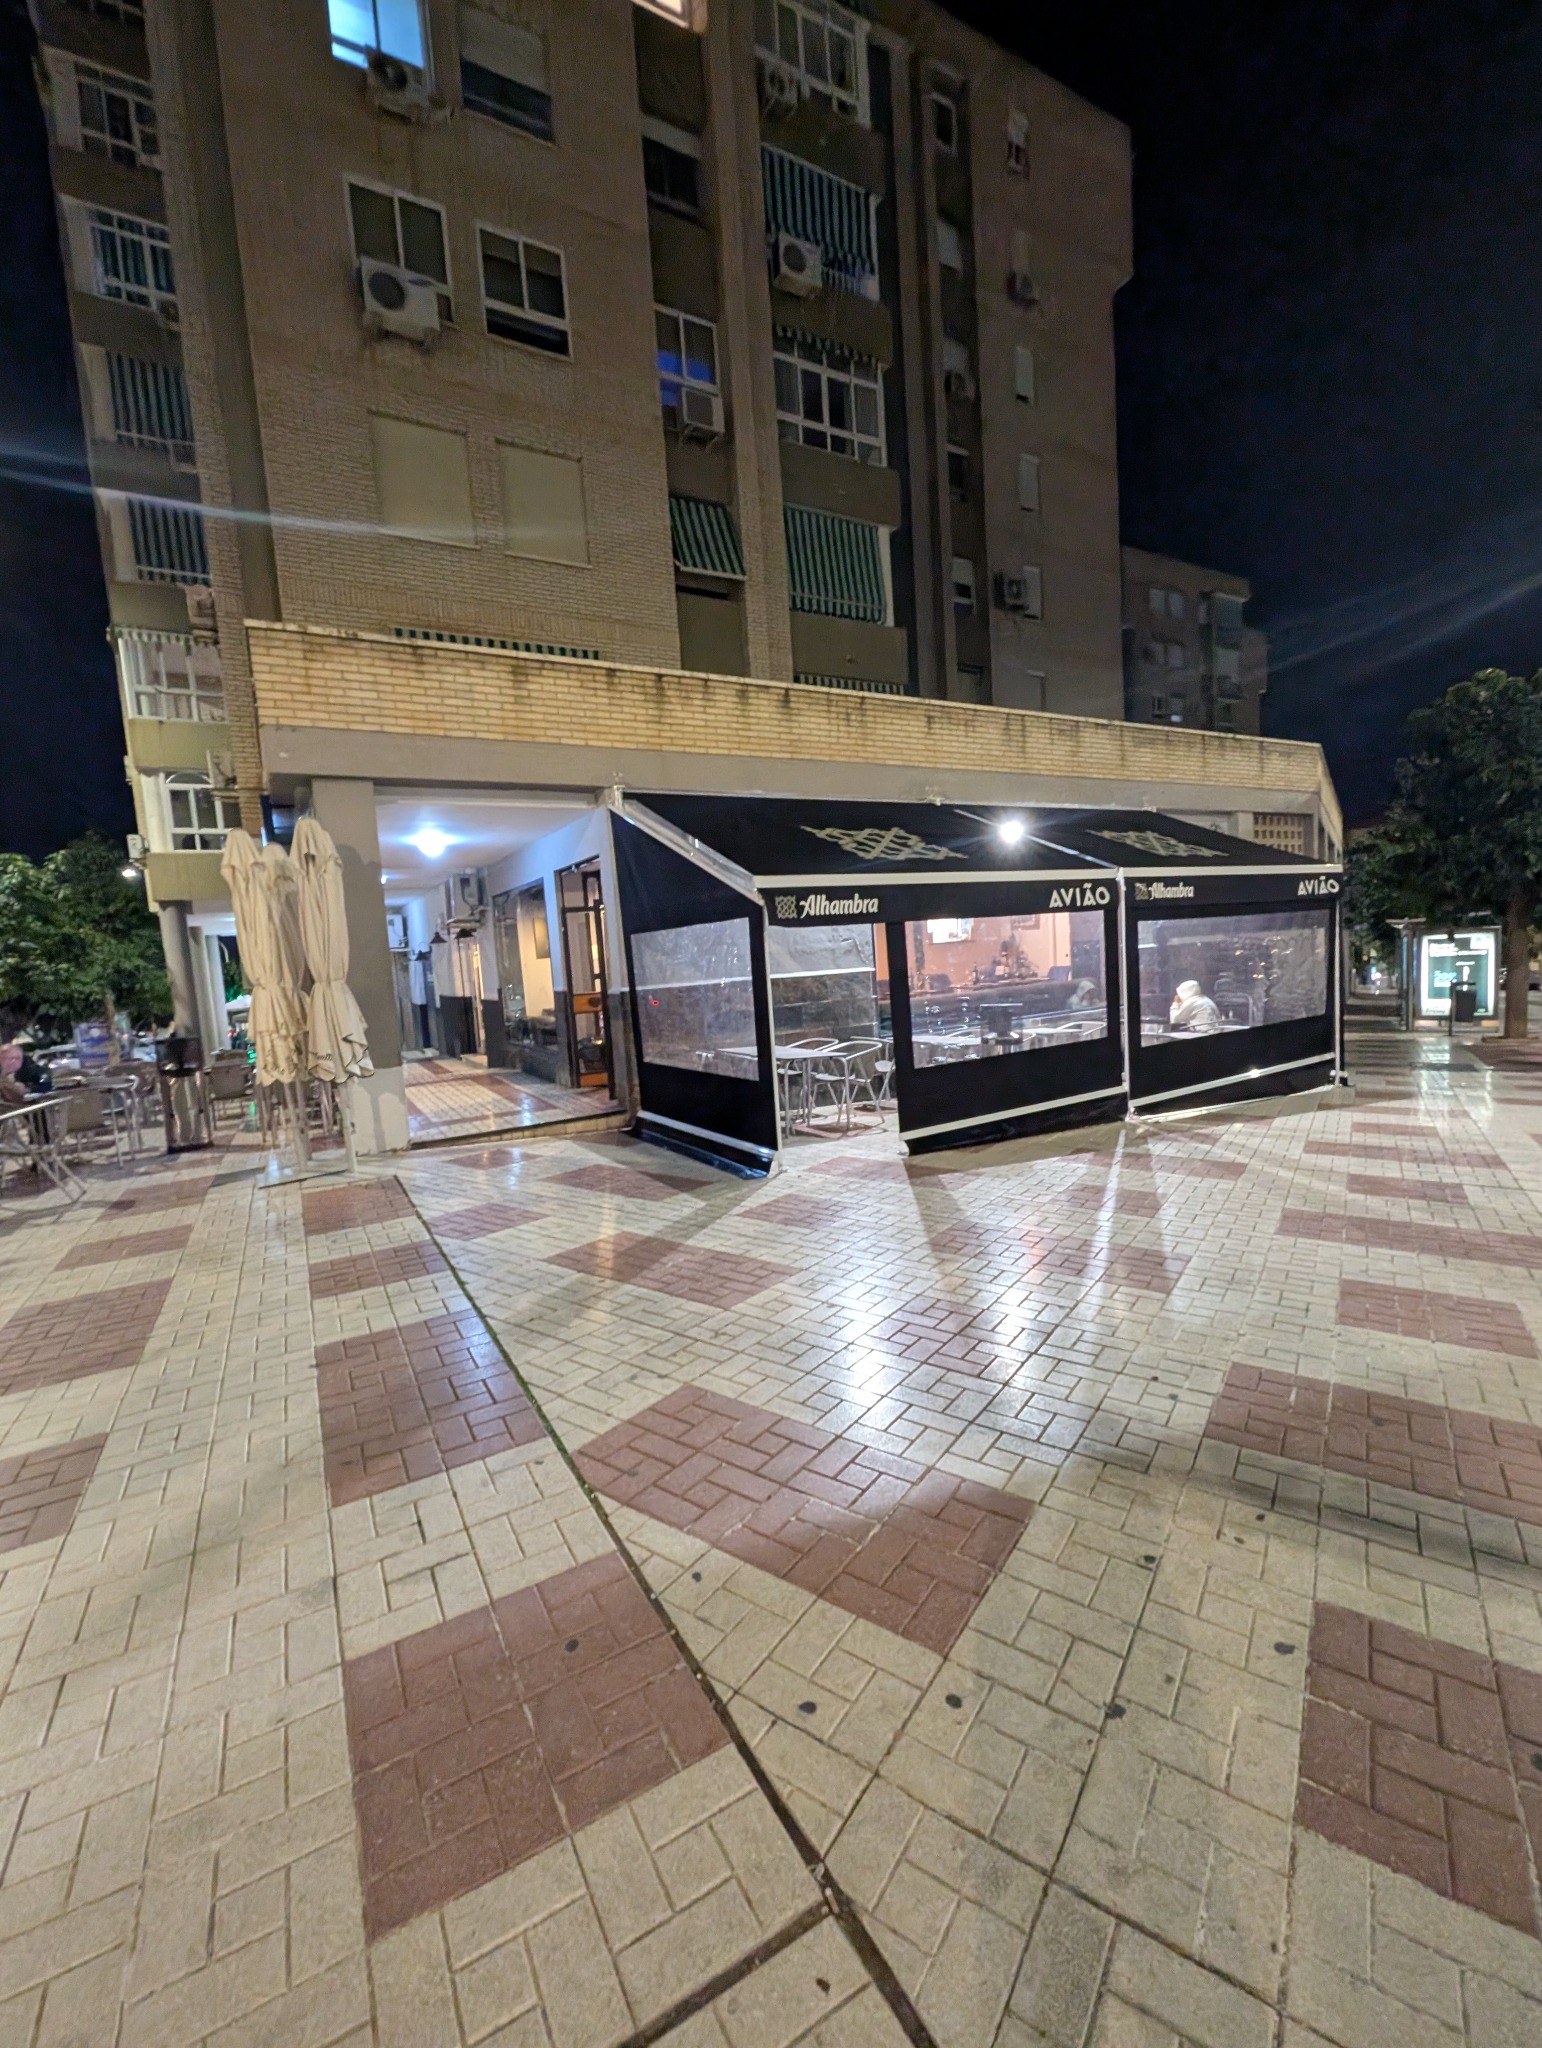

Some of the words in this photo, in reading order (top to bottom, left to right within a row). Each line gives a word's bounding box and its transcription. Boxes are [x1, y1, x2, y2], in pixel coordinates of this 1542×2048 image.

[1049, 882, 1111, 908] AVIÃO
[1149, 882, 1195, 900] Alhambra
[1297, 875, 1340, 896] AVIÃO
[800, 893, 879, 919] Alhambra
